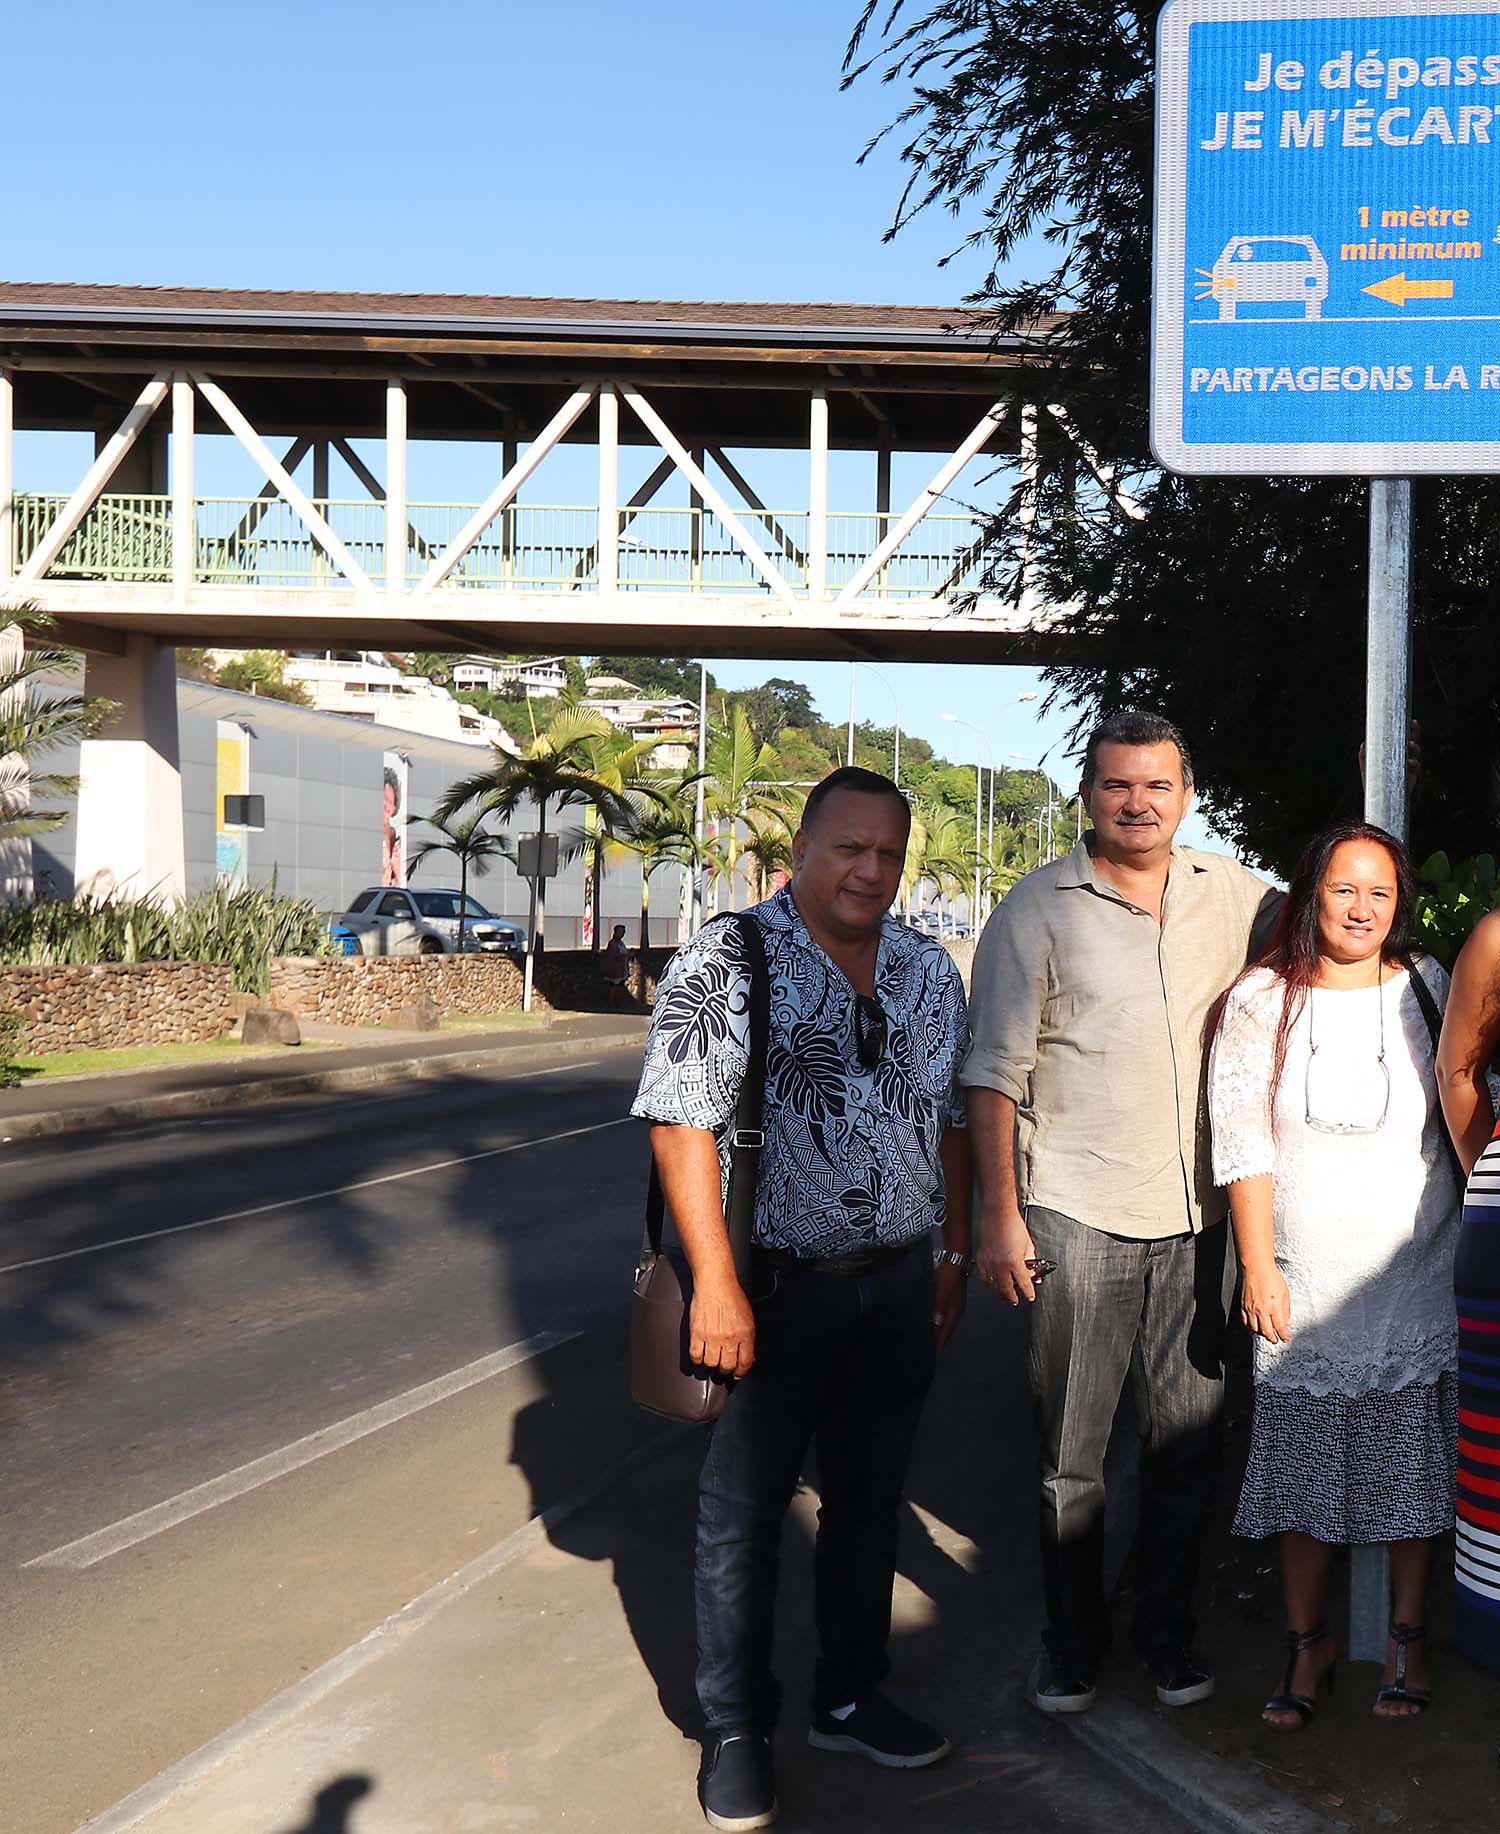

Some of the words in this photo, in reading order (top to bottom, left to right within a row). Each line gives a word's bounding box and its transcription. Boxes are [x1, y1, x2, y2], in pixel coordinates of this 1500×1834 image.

[1244, 52, 1305, 92] Je
[1200, 110, 1264, 151] JE
[1357, 205, 1371, 229] 1
[1380, 204, 1471, 228] mètre
[1339, 236, 1483, 261] minimum
[1189, 365, 1414, 393] PARTAGEONS
[1423, 364, 1471, 391] LA
